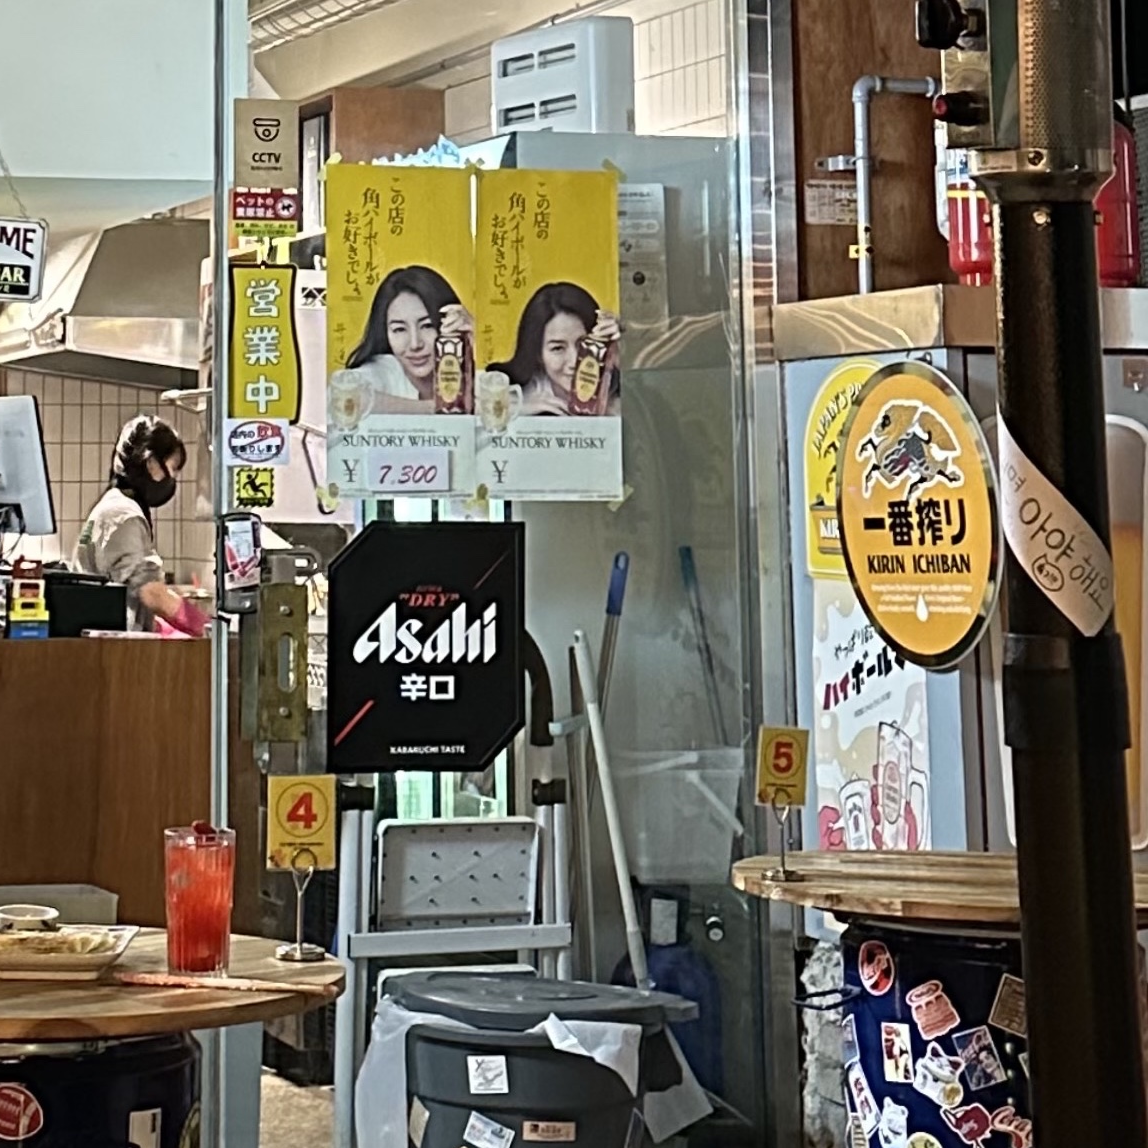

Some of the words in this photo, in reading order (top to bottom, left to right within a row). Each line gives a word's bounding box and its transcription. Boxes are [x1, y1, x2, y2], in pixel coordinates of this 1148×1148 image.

[252, 152, 282, 164] CCTV
[387, 177, 406, 237] この店の
[243, 279, 282, 415] 営業中
[342, 434, 405, 448] SUNTORY
[410, 434, 461, 448] WHISKY
[491, 436, 553, 449] SUNTORY
[556, 436, 606, 449] WHISKY
[820, 518, 840, 539] KIR
[863, 498, 967, 546] 一番搾り
[867, 554, 906, 574] KIRIN
[912, 553, 971, 574] ICHIBAN
[352, 602, 497, 663] Asahi
[400, 673, 455, 701] 辛口
[440, 744, 466, 755] TASTE
[772, 742, 794, 774] 5
[286, 792, 318, 829] 4
